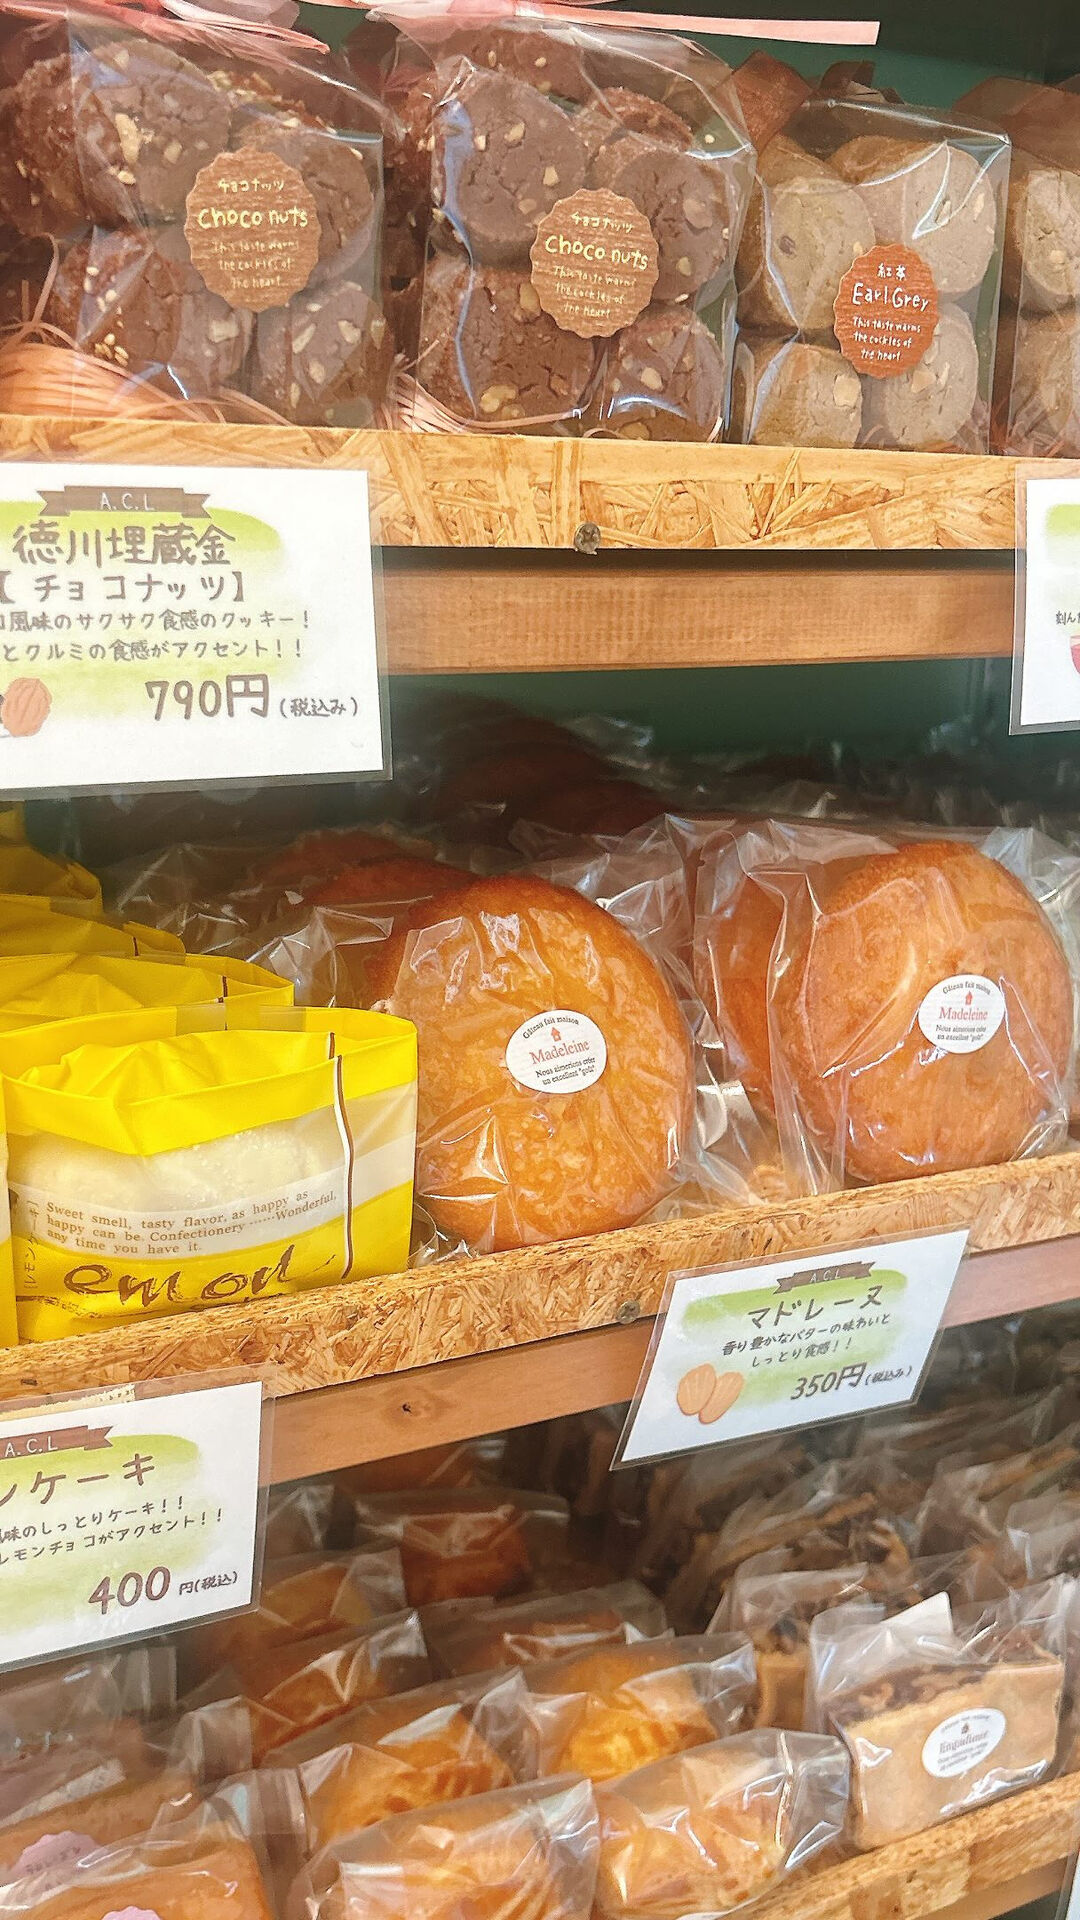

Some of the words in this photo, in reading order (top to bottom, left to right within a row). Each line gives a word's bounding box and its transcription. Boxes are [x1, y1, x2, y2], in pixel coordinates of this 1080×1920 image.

[269, 206, 308, 228] nuts
[611, 249, 649, 271] nuts
[877, 262, 906, 281] 紅茶
[852, 282, 888, 306] Earl
[891, 287, 929, 312] Grey
[853, 316, 870, 328] This
[853, 331, 868, 344] the
[12, 518, 237, 568] 徳川埋蔵金
[0, 609, 311, 633] 風味のサクサク食感のクッキー!
[145, 674, 270, 721] 790円
[939, 1006, 988, 1021] Madeleine
[529, 1040, 590, 1065] Madeleine
[46, 1202, 84, 1221] Sweet
[92, 1215, 132, 1230] smell,
[141, 1219, 175, 1231] tasty
[232, 1211, 245, 1221] as
[252, 1196, 289, 1215] happy
[296, 1190, 308, 1202] as
[46, 1214, 85, 1235] happy
[93, 1229, 116, 1240] can
[150, 1222, 245, 1242] Confectionery
[47, 1228, 68, 1244] any
[76, 1238, 105, 1251] time
[114, 1244, 138, 1254] you
[147, 1243, 179, 1254] have
[748, 1284, 883, 1329] マドレーヌ
[790, 1362, 868, 1400] 350円
[5, 1436, 58, 1457] A.C.L
[0, 1496, 183, 1543] 味のしっとりケーキ!!
[88, 1566, 171, 1614] 400
